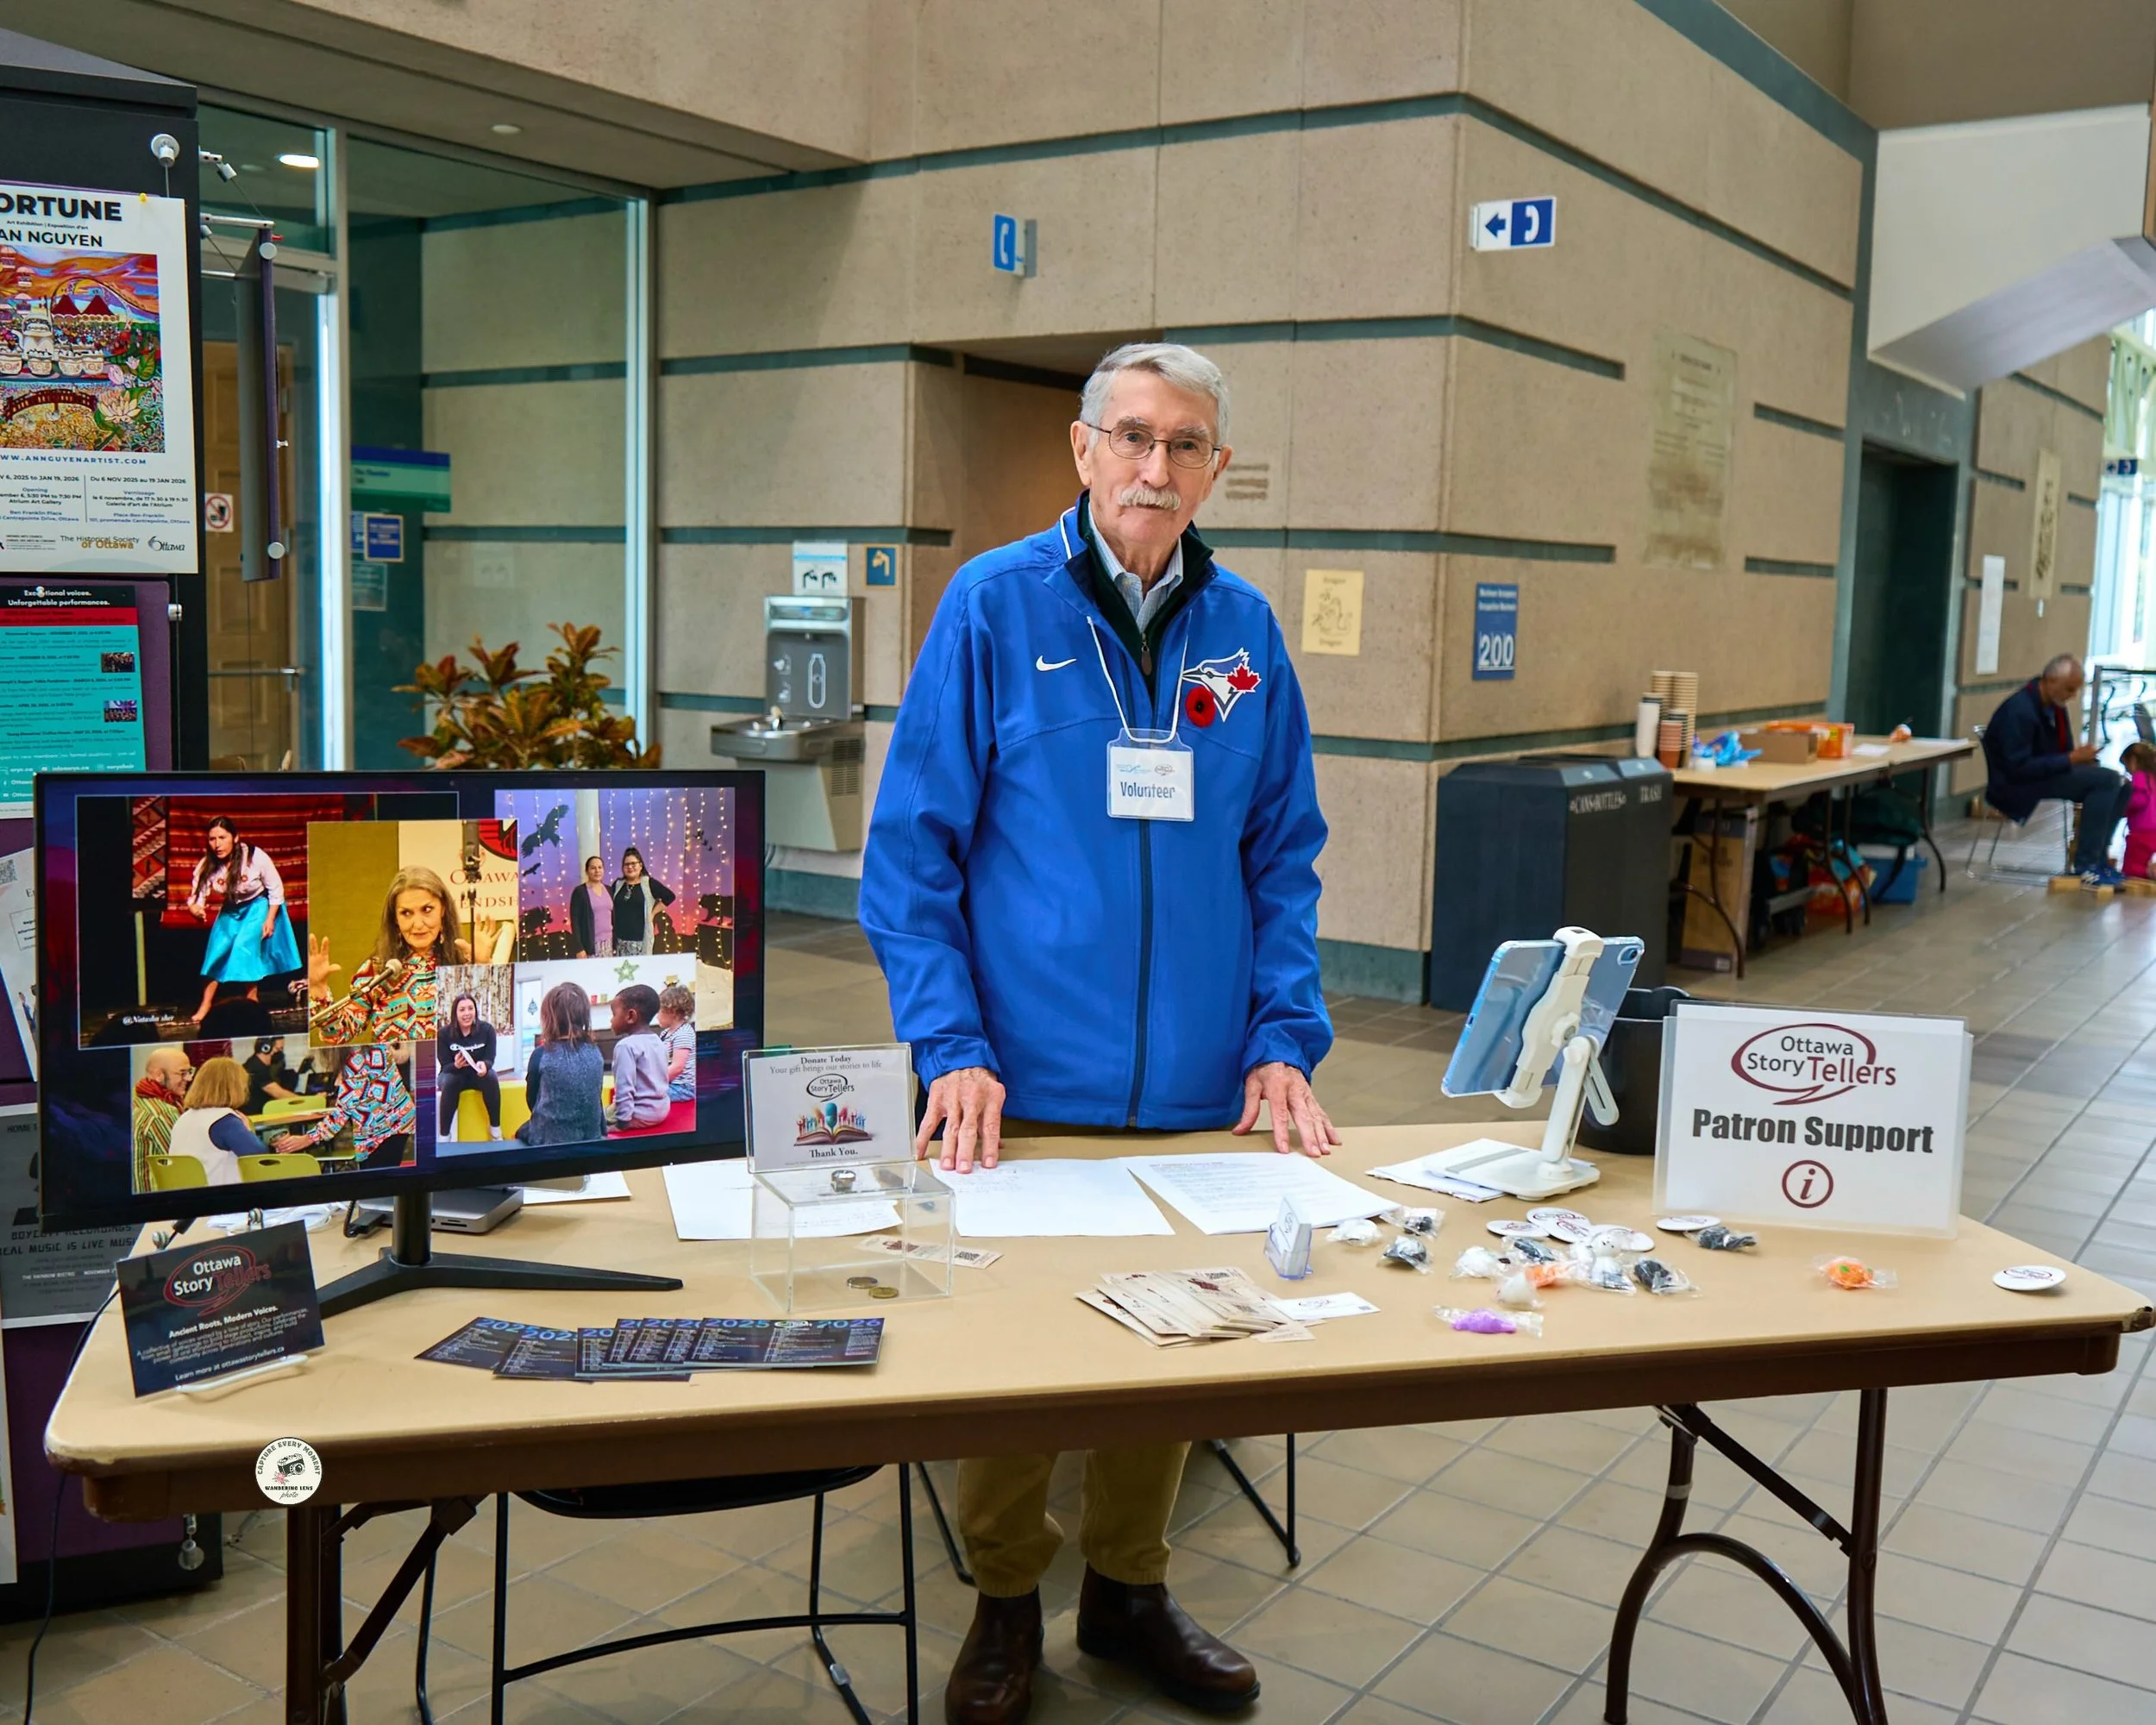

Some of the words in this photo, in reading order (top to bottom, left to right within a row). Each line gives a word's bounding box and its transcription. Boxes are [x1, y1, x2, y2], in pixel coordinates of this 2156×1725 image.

[0, 192, 122, 222] ORTUNE
[28, 231, 103, 248] NGUYEN
[96, 541, 135, 549] Ottawa
[8, 599, 58, 607] Unforgettable
[59, 599, 110, 607] performances.
[1479, 634, 1514, 668] 200
[1119, 781, 1175, 799] Volunteer
[450, 869, 518, 885] OAWA
[1781, 1036, 1854, 1056] Ottawa
[800, 1056, 828, 1065] Donate
[830, 1055, 852, 1065] Today
[769, 1065, 788, 1075] Your
[789, 1063, 801, 1076] gift
[802, 1062, 824, 1074] brings
[839, 1062, 861, 1070] stories
[871, 1061, 882, 1070] life
[1692, 1108, 1796, 1145] Patron
[1804, 1115, 1934, 1154] Support
[809, 1147, 837, 1158] Thank
[839, 1147, 859, 1157] You.
[28, 1242, 62, 1253] MUSIC
[67, 1241, 77, 1251] IS
[81, 1239, 104, 1250] LIVE
[110, 1237, 135, 1247] MUSI
[192, 1255, 242, 1276] Ottawa
[169, 1325, 198, 1339] Ancient
[197, 1319, 222, 1331] Roots,
[223, 1311, 254, 1324] Modern
[253, 1305, 279, 1316] Voices.
[705, 1319, 770, 1328] 2025
[522, 1329, 578, 1342] 202
[174, 1370, 195, 1382] Learn
[195, 1365, 212, 1375] more
[221, 1346, 285, 1369] ottawastorytellers.ca
